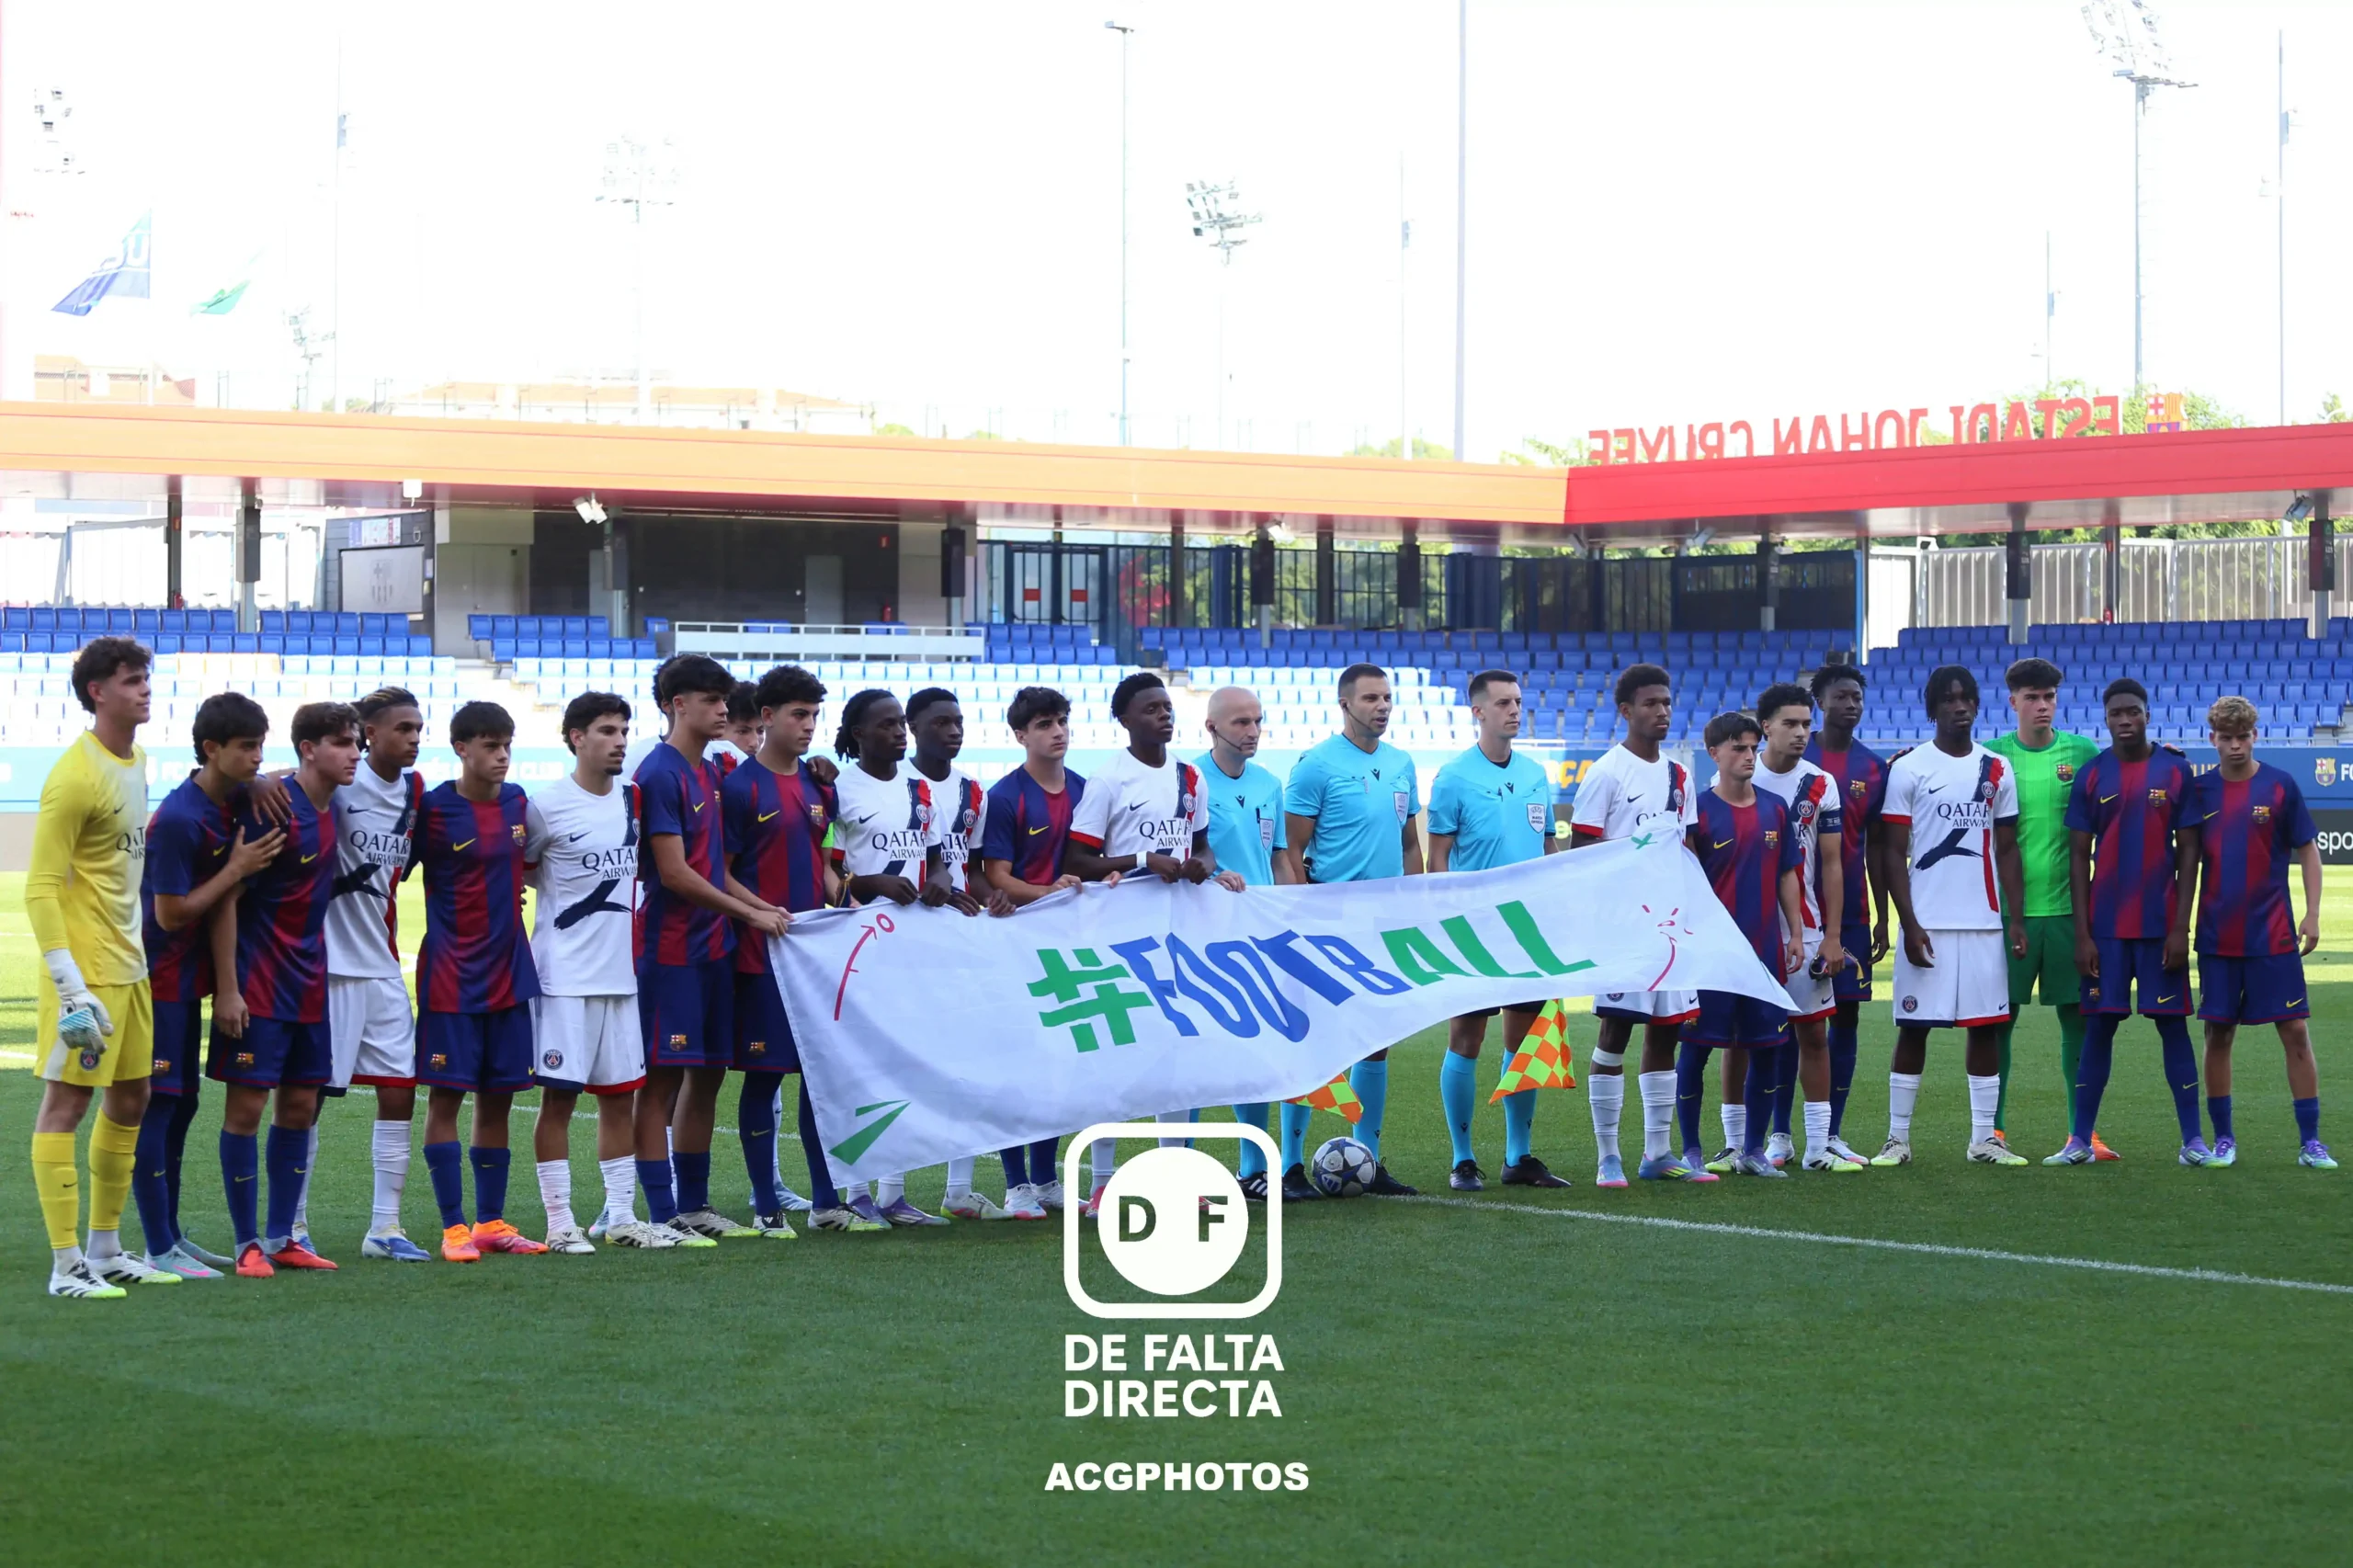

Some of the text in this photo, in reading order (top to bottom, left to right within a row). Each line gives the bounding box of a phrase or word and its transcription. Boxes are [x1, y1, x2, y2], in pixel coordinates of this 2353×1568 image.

[350, 830, 410, 855] QATAR
[582, 847, 639, 872] QATA
[1027, 900, 1597, 1052] #FOOTBALL
